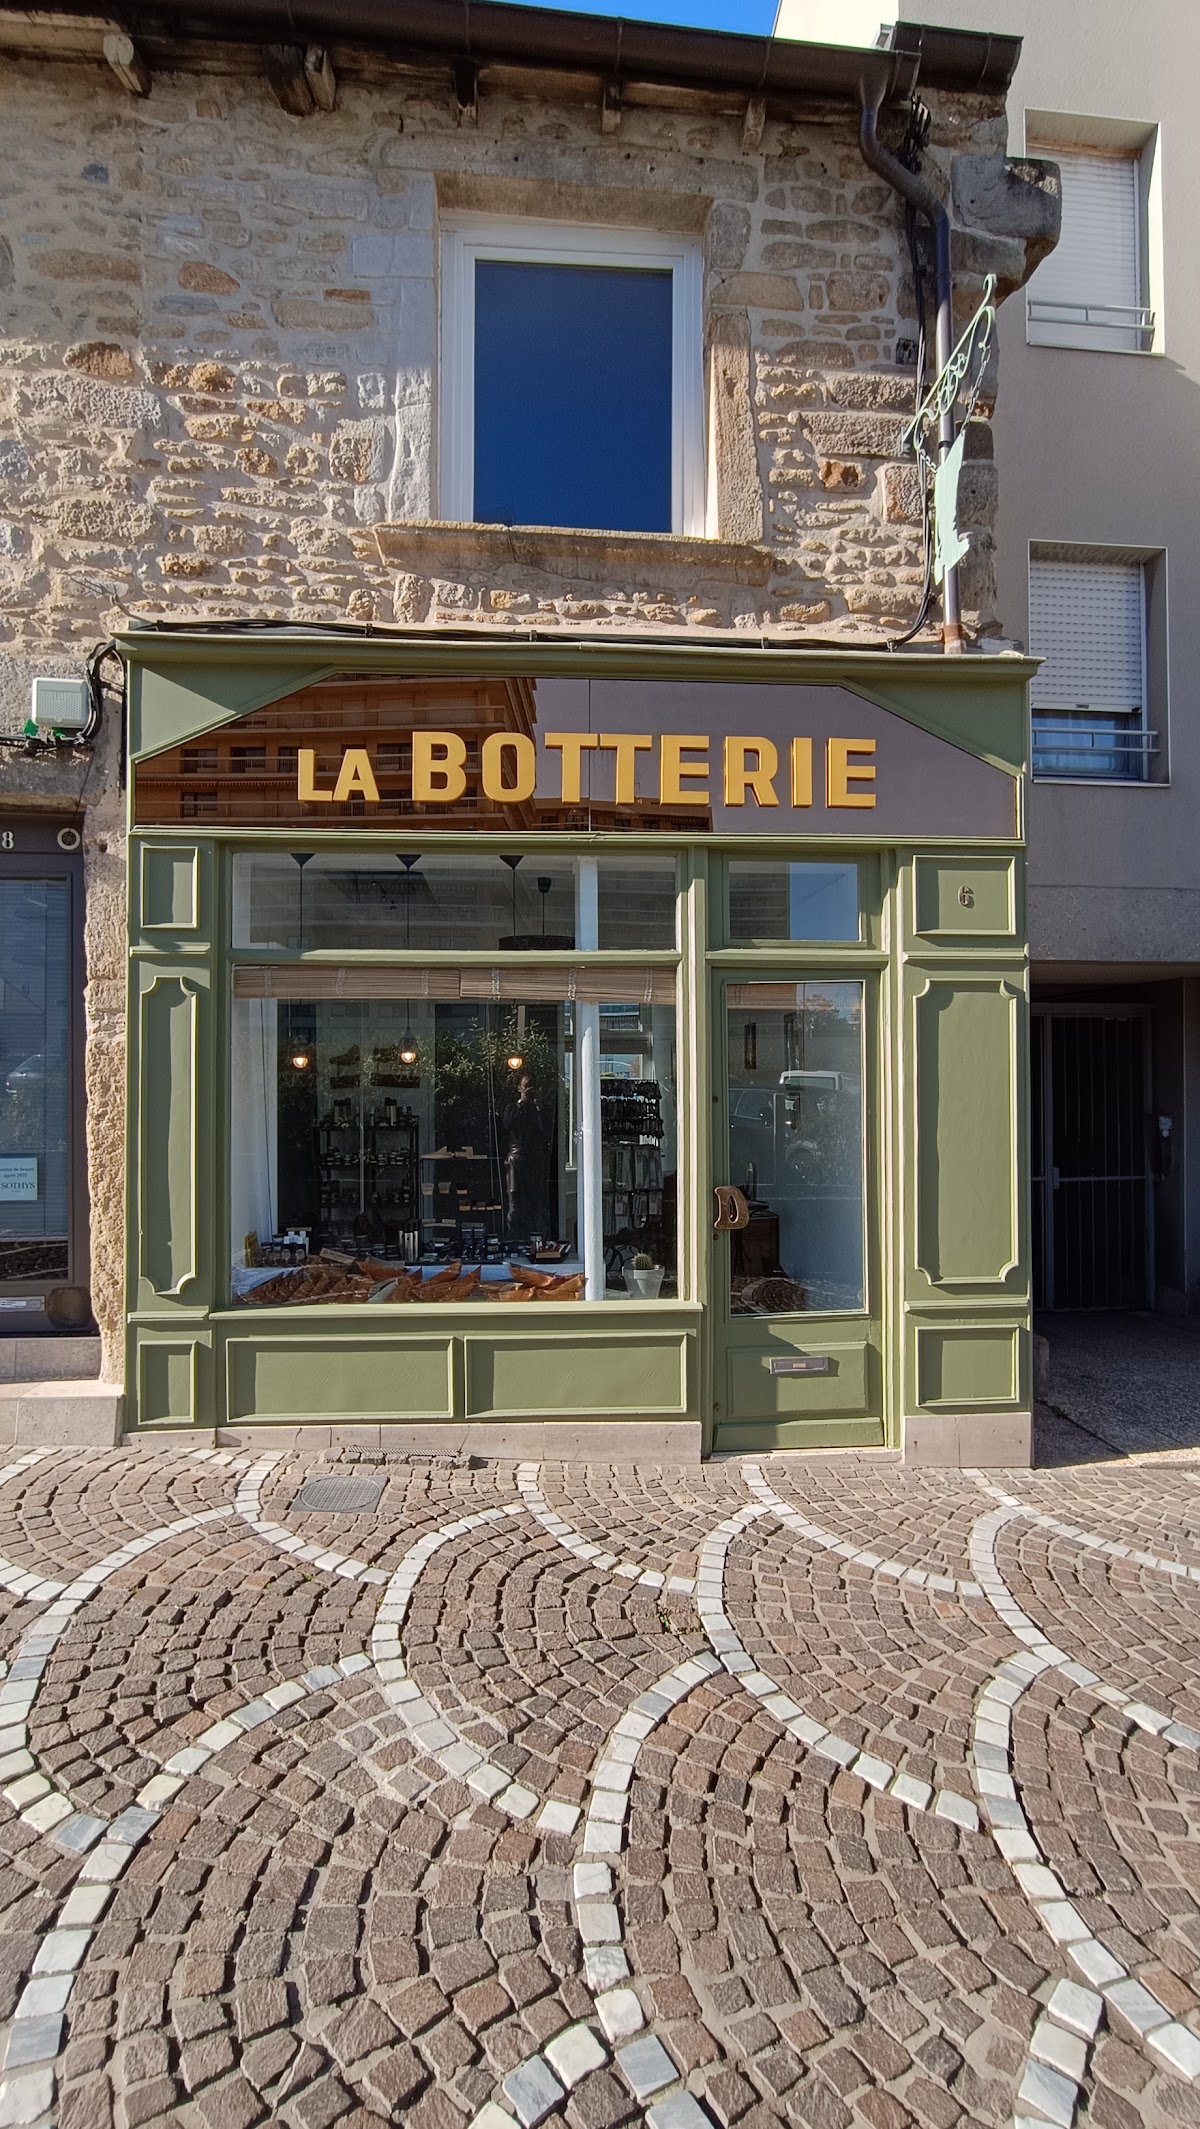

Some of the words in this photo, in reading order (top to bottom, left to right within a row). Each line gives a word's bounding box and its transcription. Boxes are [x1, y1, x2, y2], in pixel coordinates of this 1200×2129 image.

[297, 748, 380, 803] LA
[412, 731, 877, 809] BOTTERIE
[1, 831, 15, 850] 8
[957, 885, 972, 908] 6
